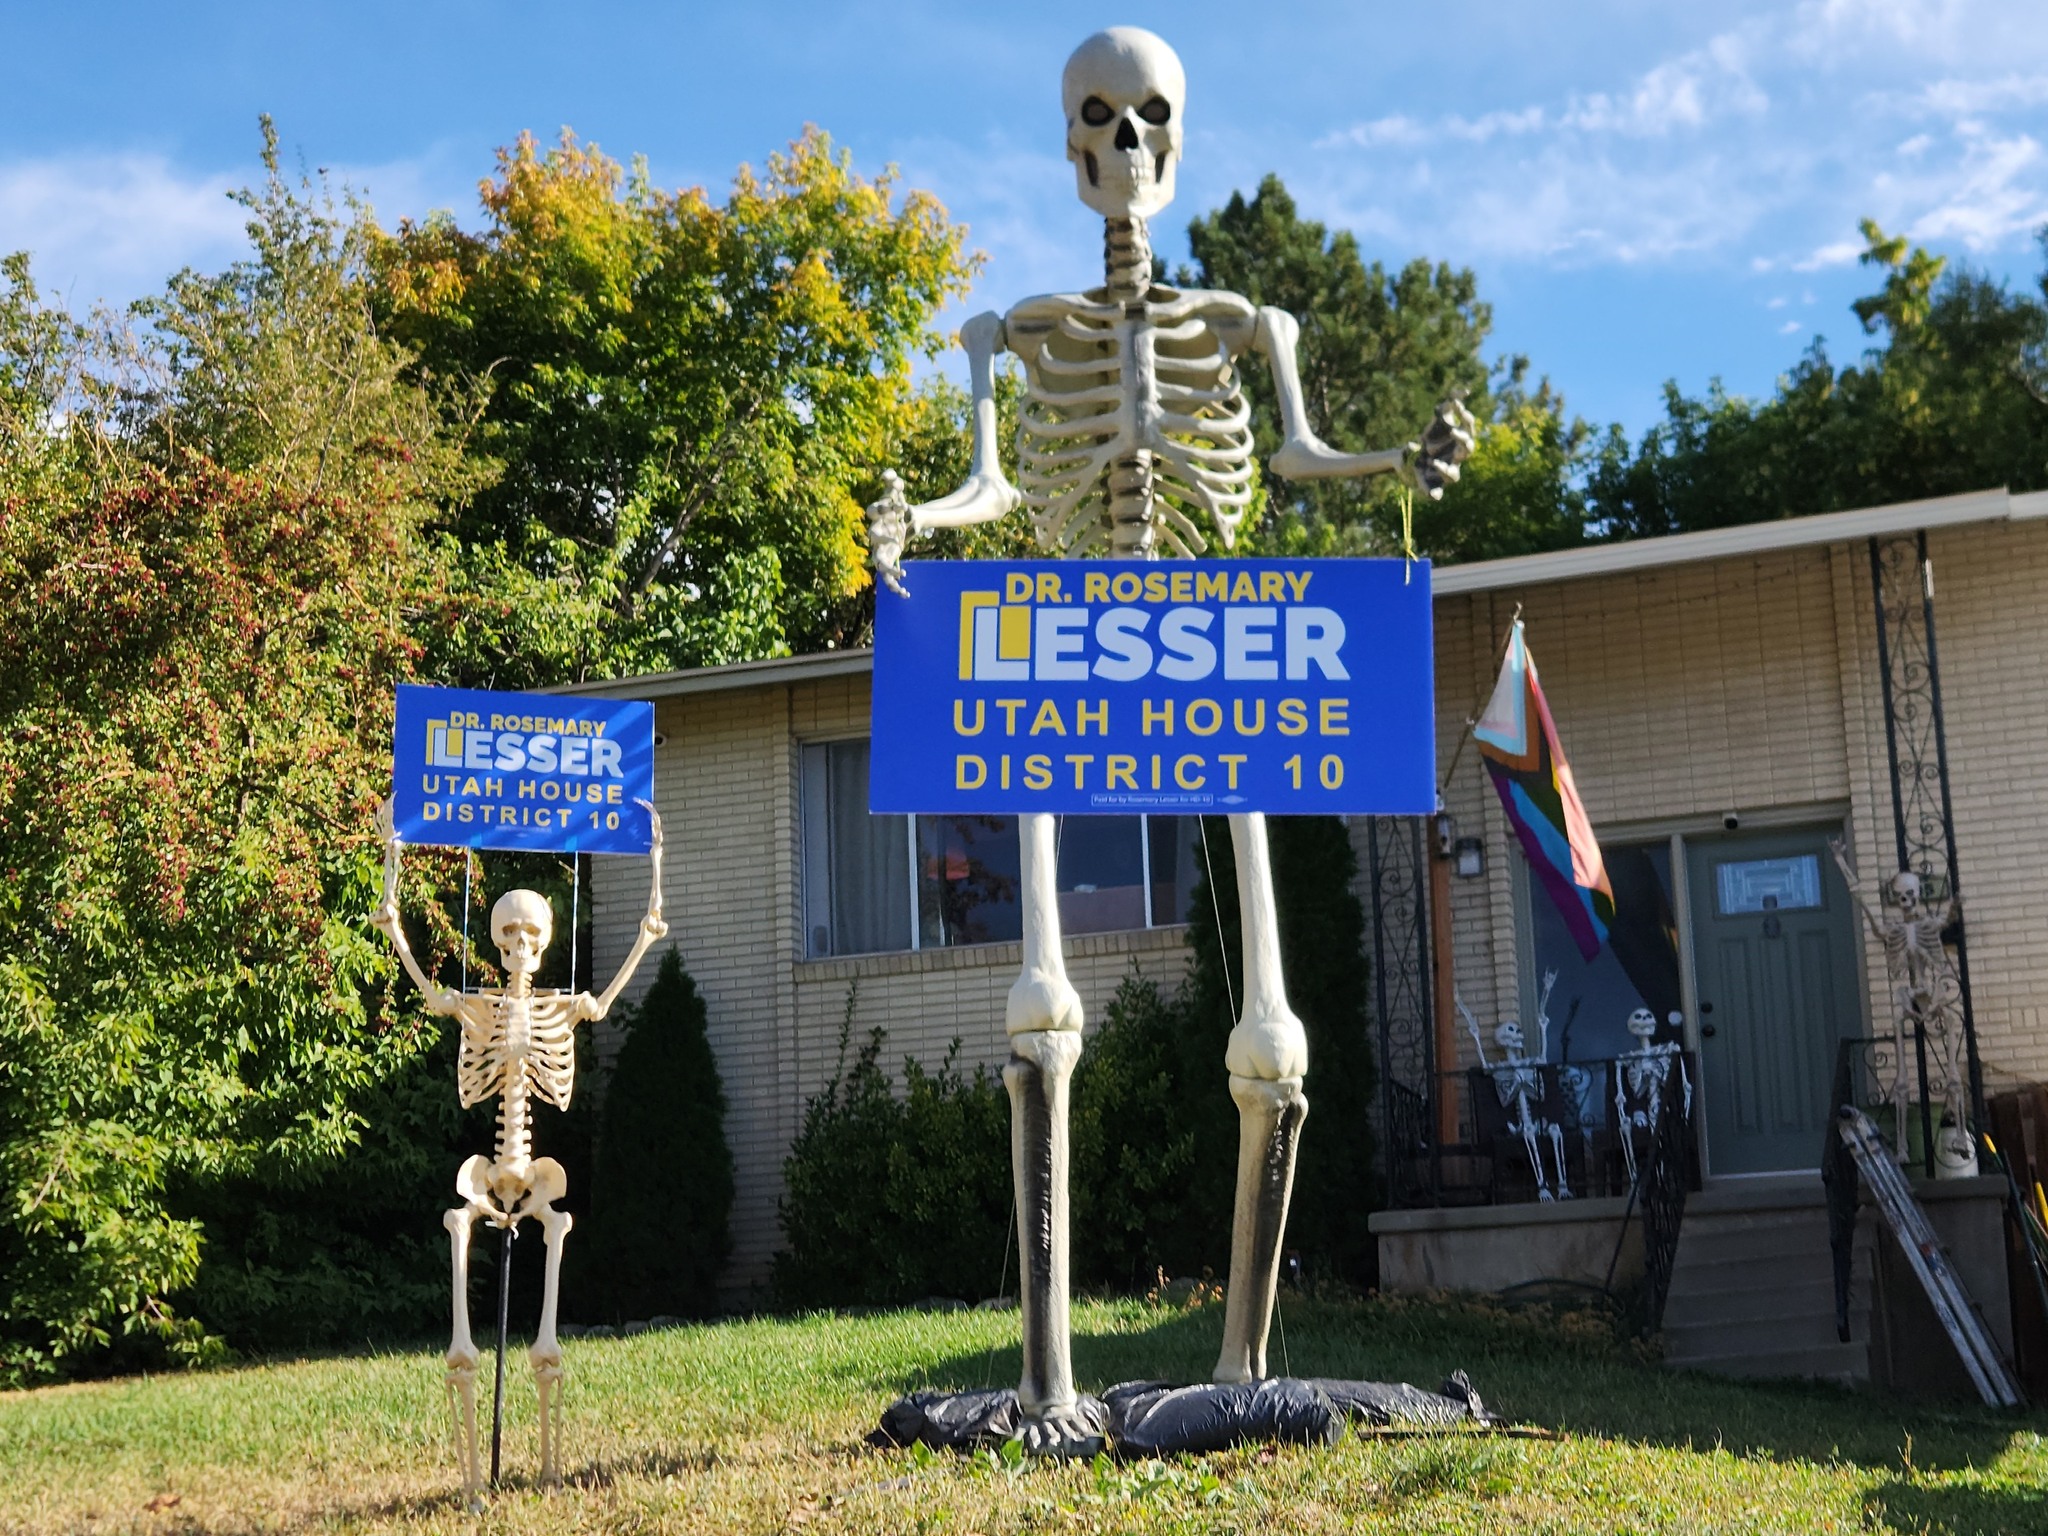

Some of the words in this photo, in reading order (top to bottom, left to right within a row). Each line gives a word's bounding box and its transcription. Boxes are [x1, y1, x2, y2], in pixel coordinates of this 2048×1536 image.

[1005, 572, 1073, 603] DR.
[1085, 571, 1313, 603] ROSEMARY
[973, 605, 1351, 681] LESSER
[450, 711, 485, 730] DR.
[491, 714, 607, 737] ROSEMARY
[953, 699, 1109, 737] UTAH
[1143, 699, 1351, 737] HOUSE
[433, 728, 624, 778] LESSER
[955, 754, 1248, 791] DISTRICT
[1283, 754, 1344, 791] 10
[422, 774, 503, 798] UTAH
[519, 779, 623, 804] HOUSE
[1118, 796, 1126, 804] by
[1128, 796, 1158, 804] Rosemary
[423, 801, 572, 828] DISTRICT
[589, 811, 619, 830] 10
